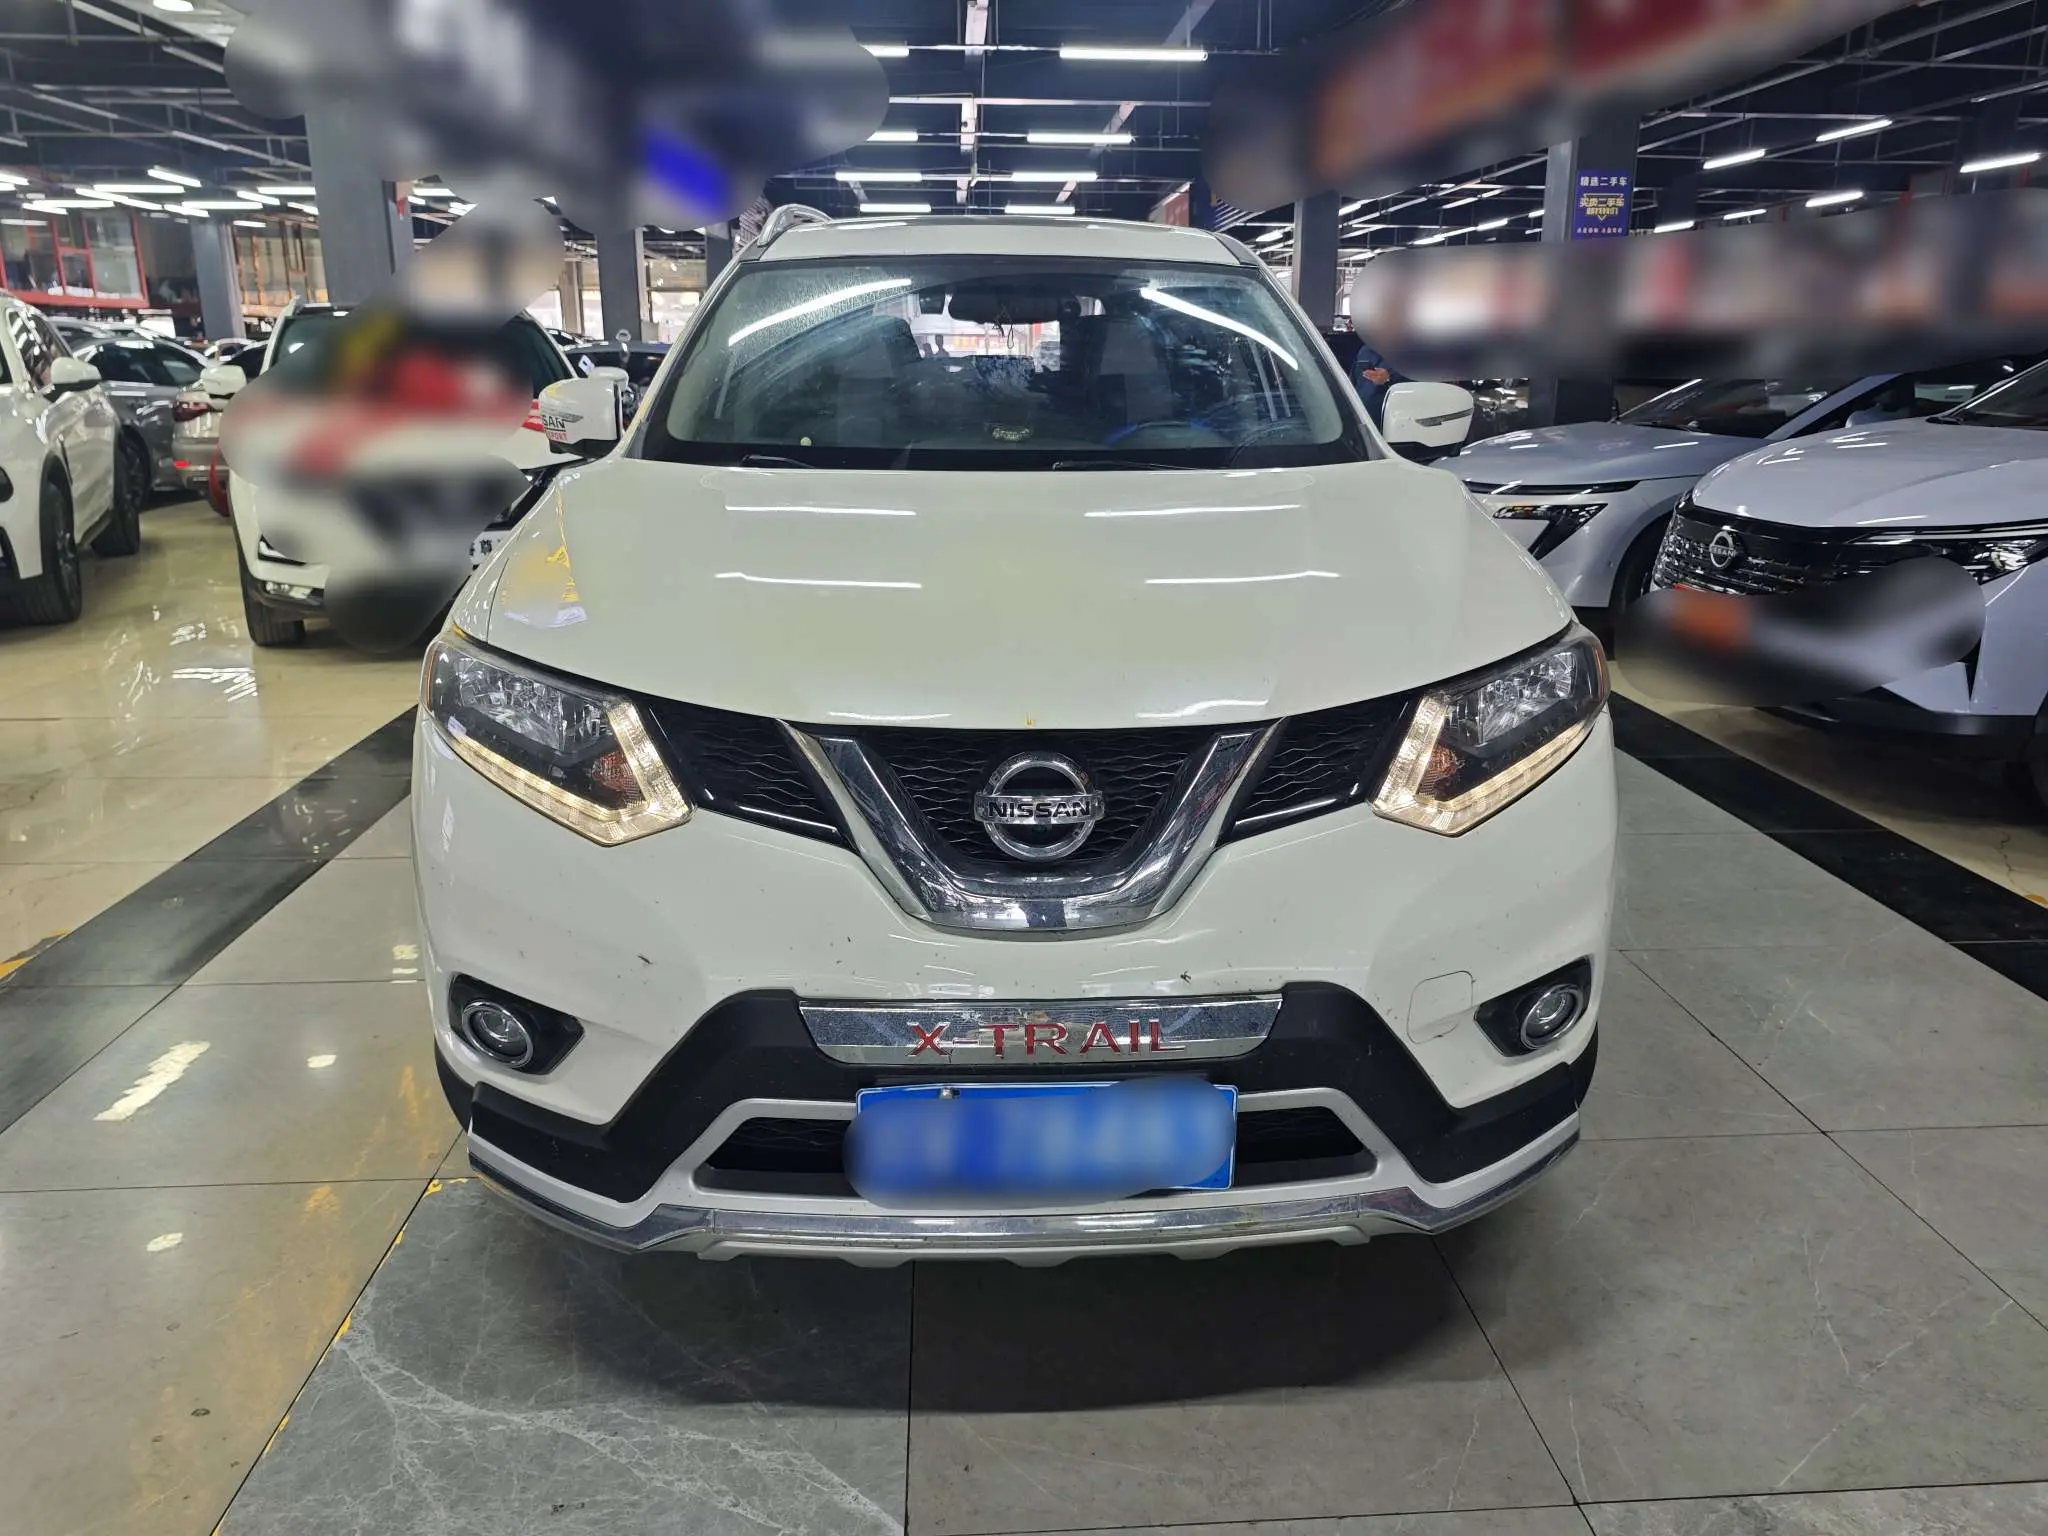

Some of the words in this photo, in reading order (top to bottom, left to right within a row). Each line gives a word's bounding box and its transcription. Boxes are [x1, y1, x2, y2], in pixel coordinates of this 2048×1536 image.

[1580, 176, 1628, 187] 精选二手车
[987, 801, 1091, 818] NISSAN
[906, 1018, 1186, 1057] X-TRAIL
